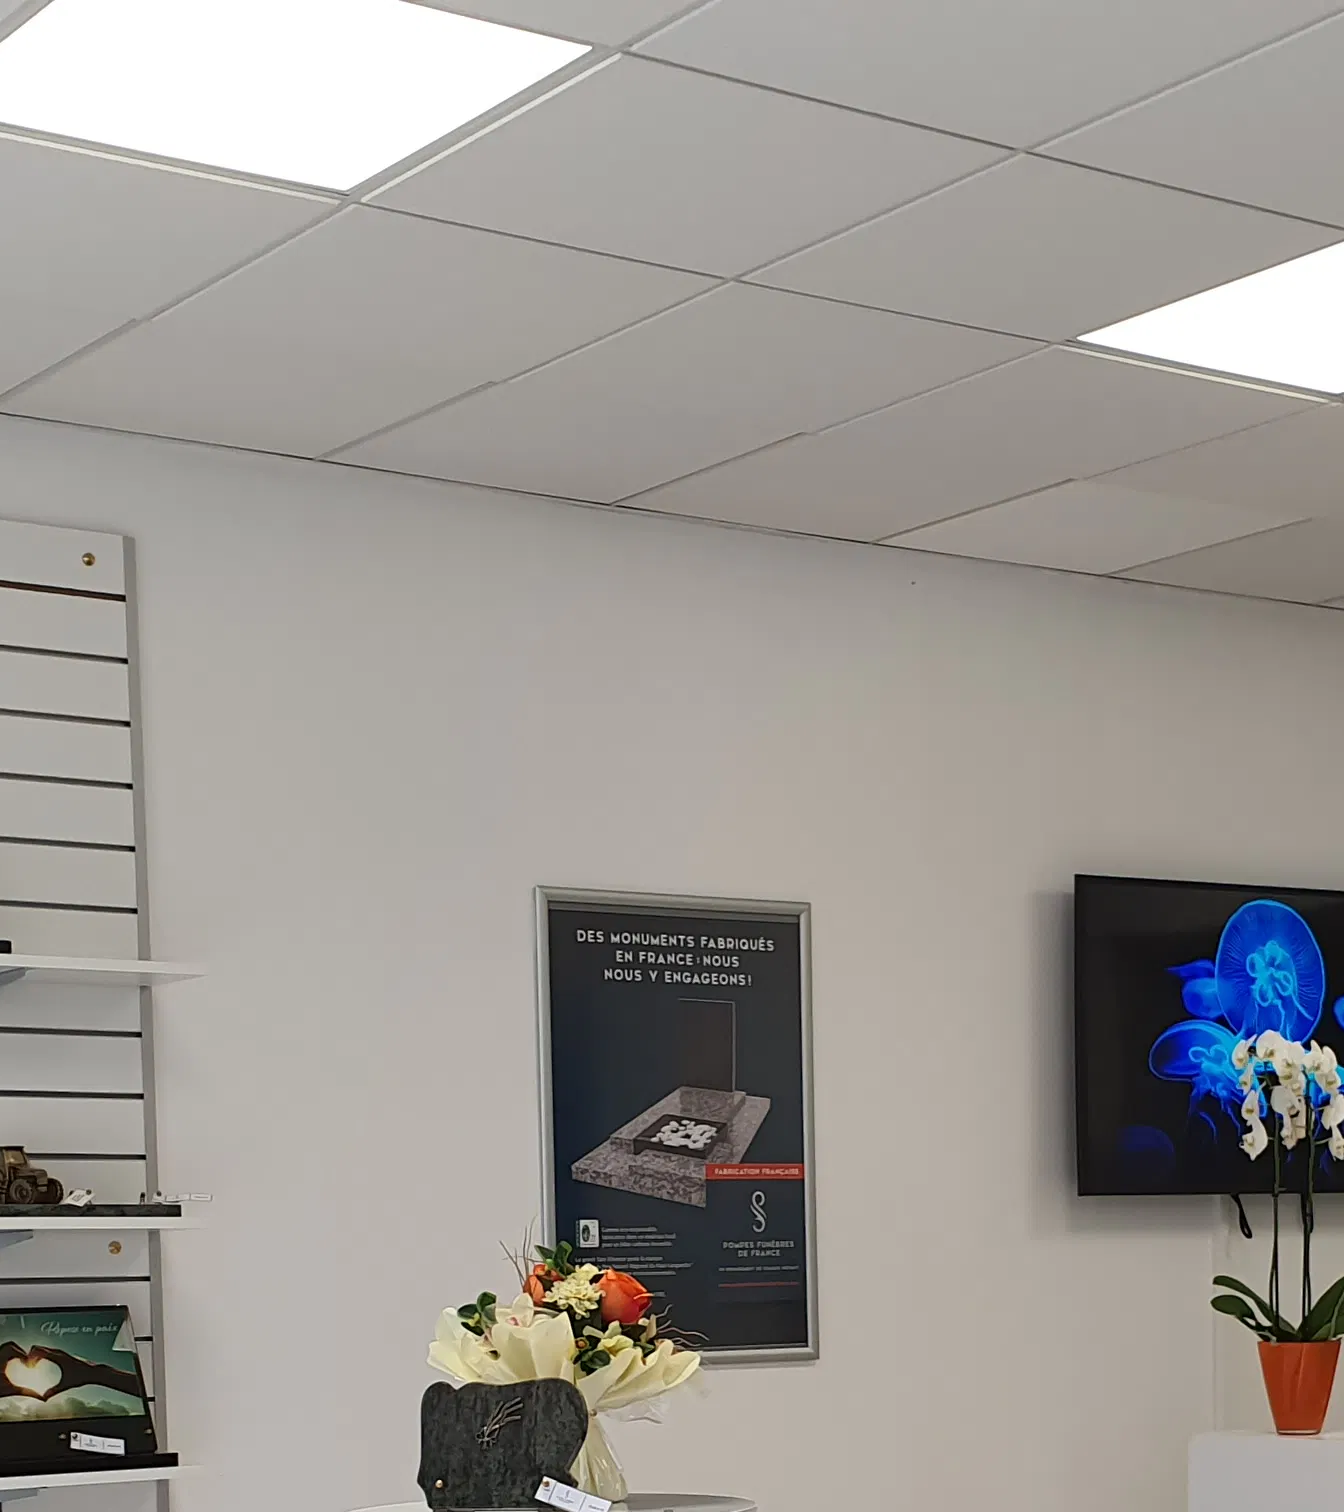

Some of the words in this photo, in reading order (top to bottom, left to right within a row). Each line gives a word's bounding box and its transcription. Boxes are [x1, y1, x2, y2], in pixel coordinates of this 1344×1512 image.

[576, 929, 605, 943] DES
[610, 932, 695, 948] MONUMENTS
[700, 936, 775, 951] FABRIQUÉS
[616, 950, 633, 963] EN
[703, 954, 740, 968] NOUS
[604, 968, 642, 982] NOUS
[649, 970, 658, 982] Y
